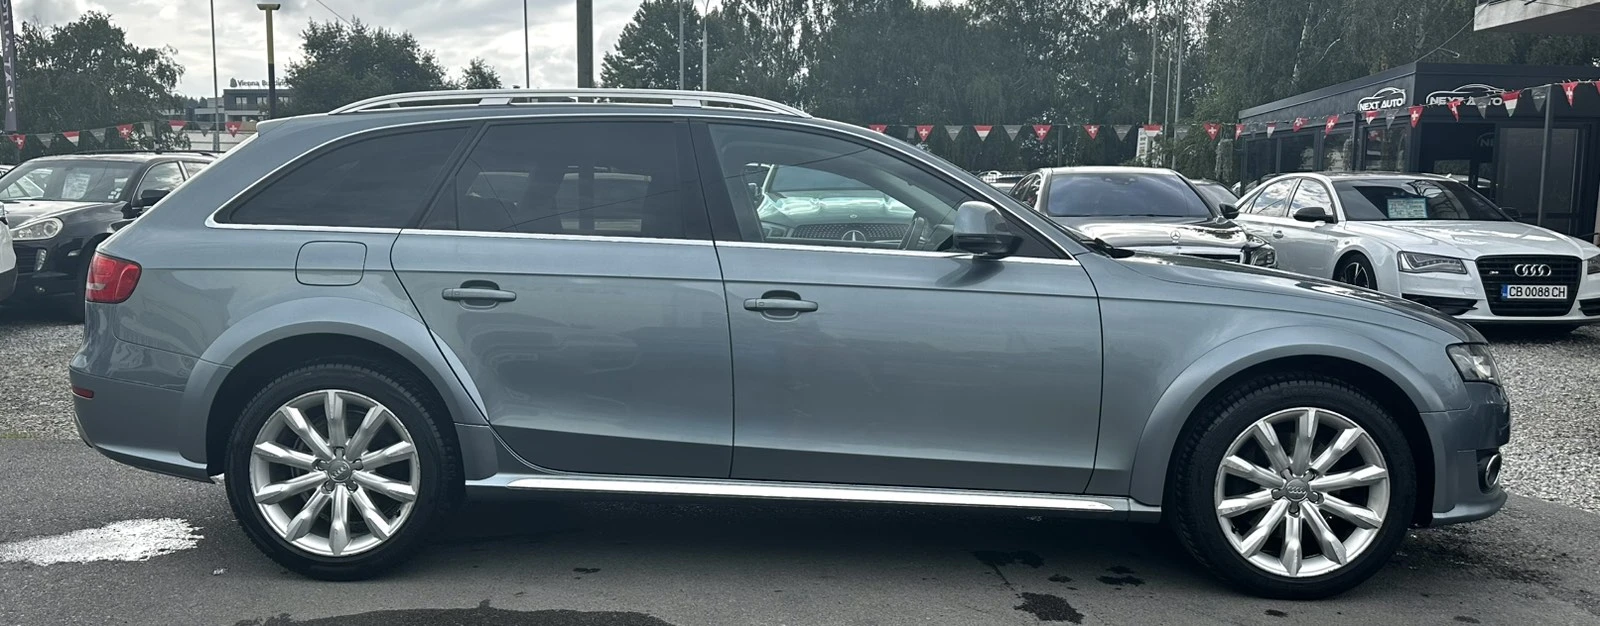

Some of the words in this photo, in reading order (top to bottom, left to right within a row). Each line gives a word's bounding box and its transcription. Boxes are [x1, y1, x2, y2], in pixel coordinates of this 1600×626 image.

[1359, 101, 1380, 111] NEXT
[1380, 97, 1403, 109] AUTO
[1508, 286, 1523, 297] CB
[1524, 286, 1550, 297] 0088
[1551, 286, 1566, 298] CH
